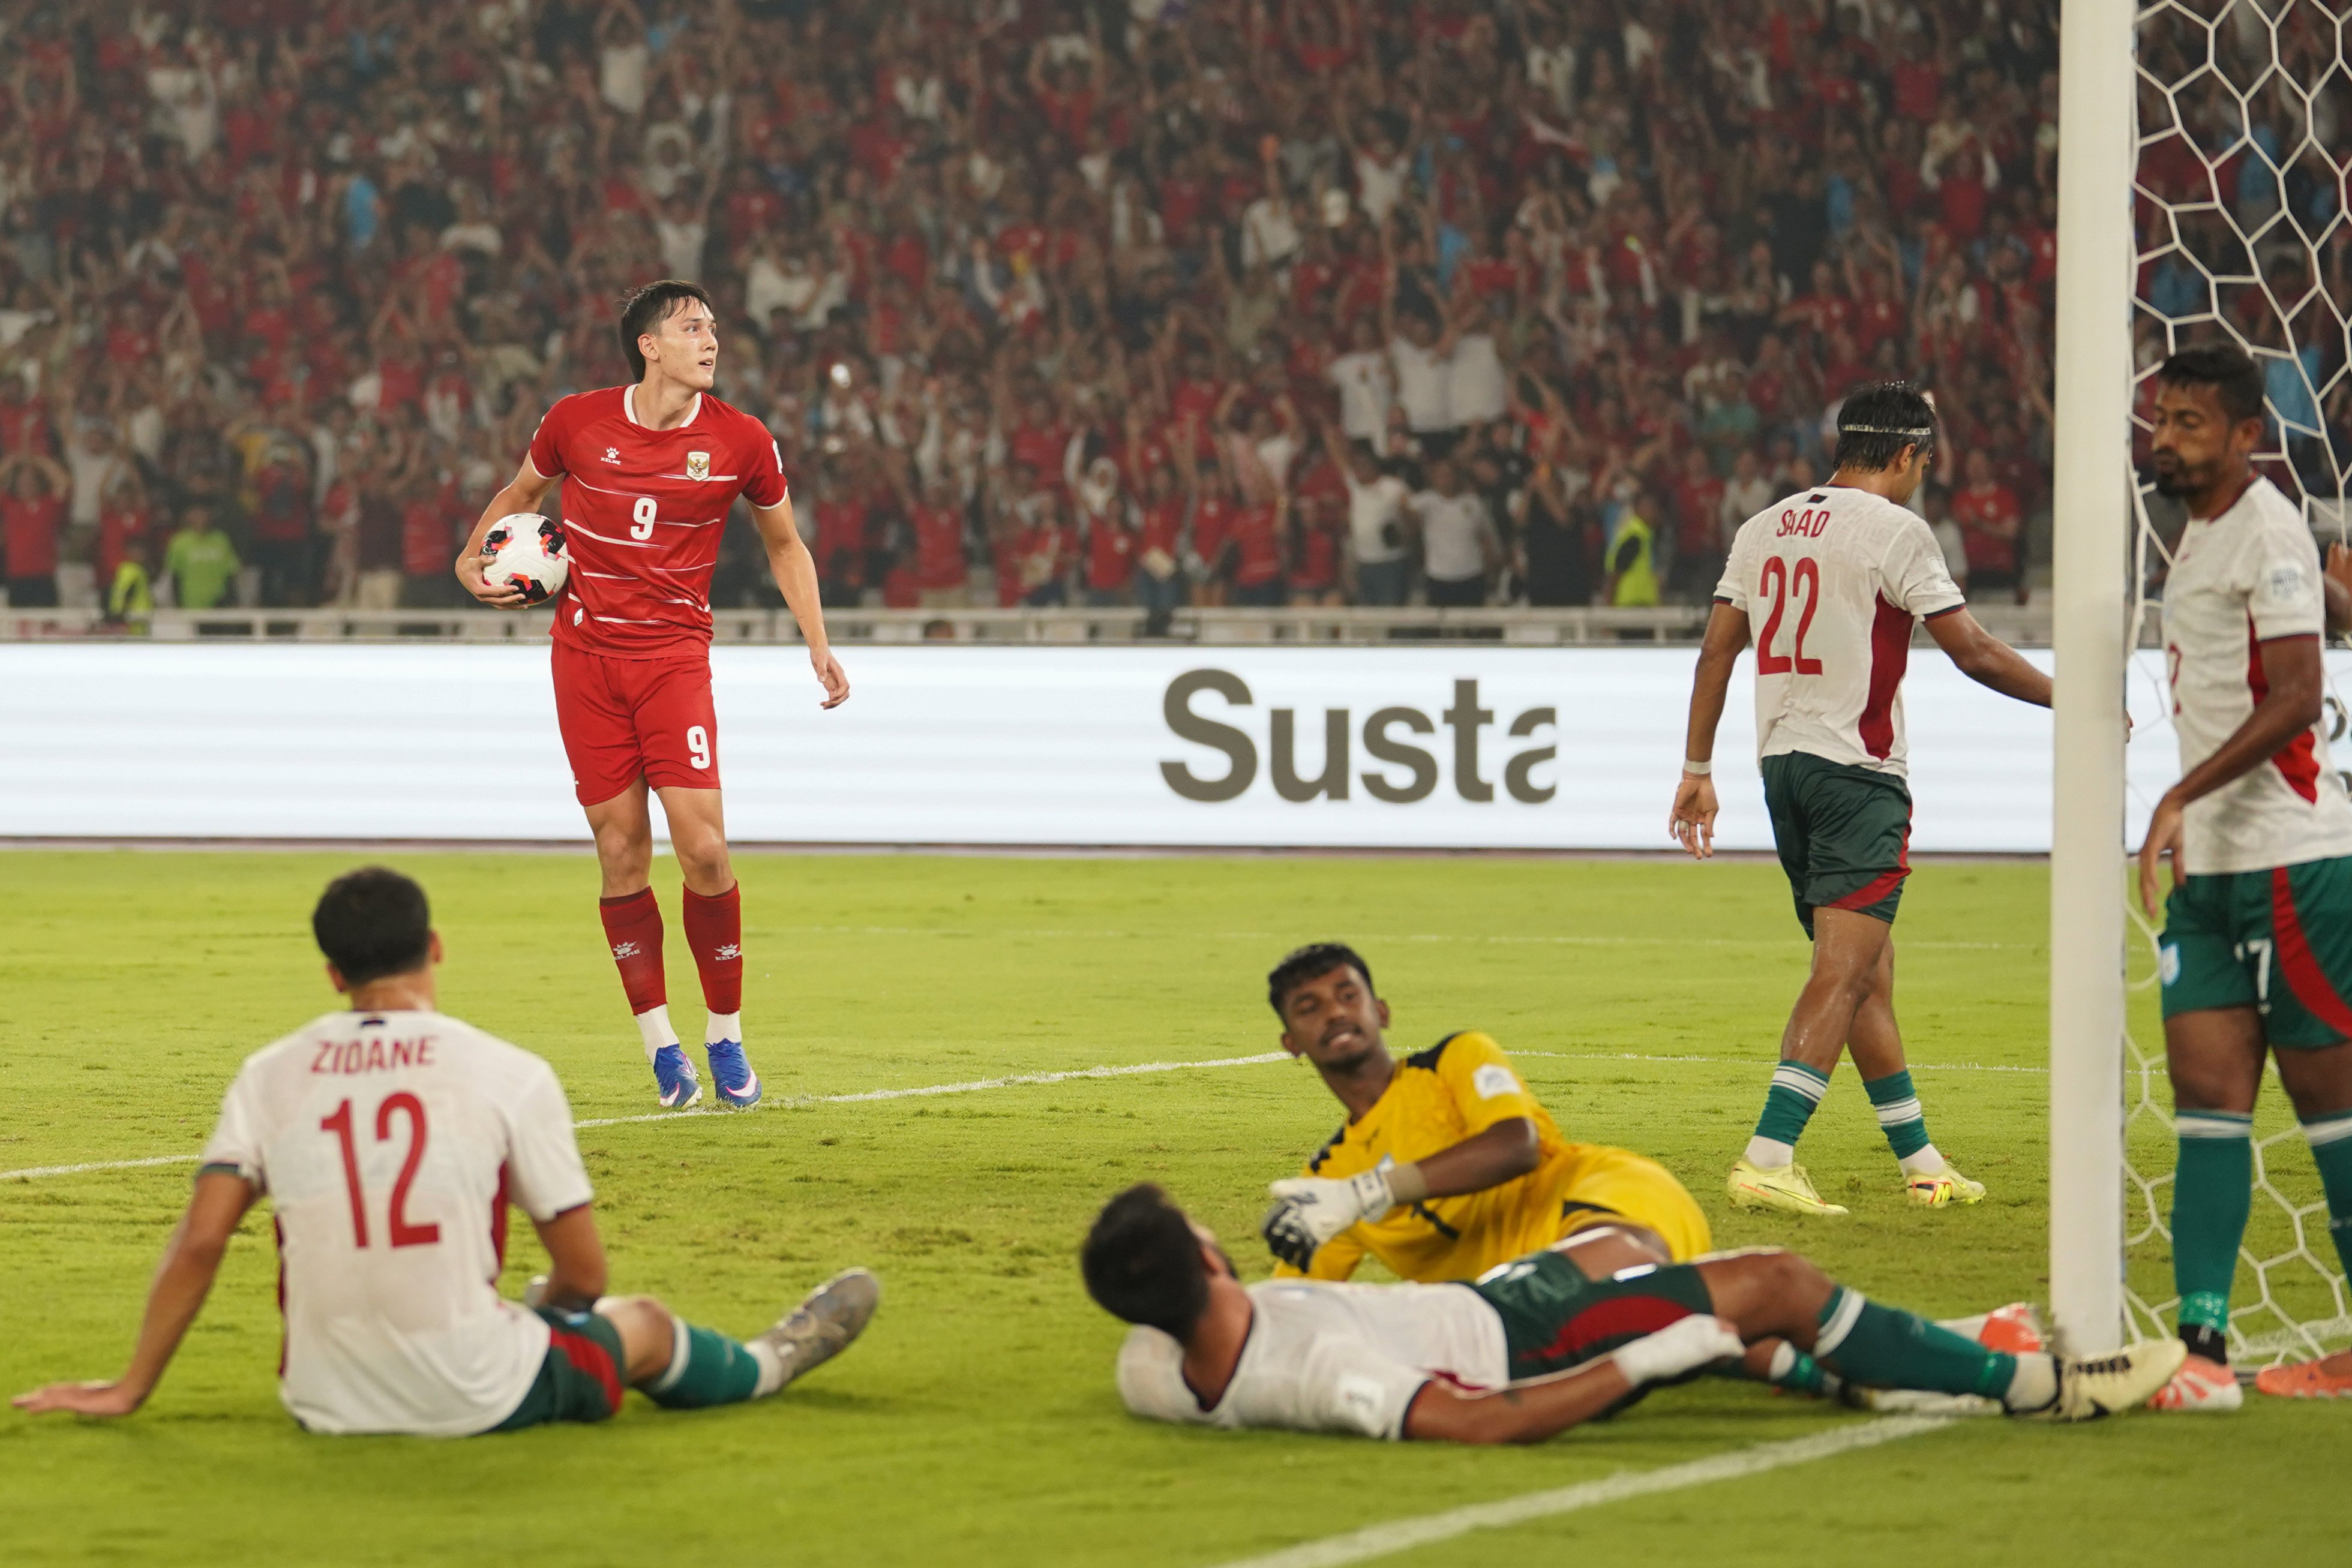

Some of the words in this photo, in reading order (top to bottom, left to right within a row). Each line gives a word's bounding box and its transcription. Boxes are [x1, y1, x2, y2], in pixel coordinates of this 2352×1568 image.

[601, 456, 622, 465] KELME
[630, 497, 658, 540] 9
[1757, 555, 1823, 675] 22
[687, 725, 711, 770] 9
[1160, 668, 1556, 804] Susta
[311, 1034, 439, 1074] ZIDANE
[320, 1091, 440, 1249] 12
